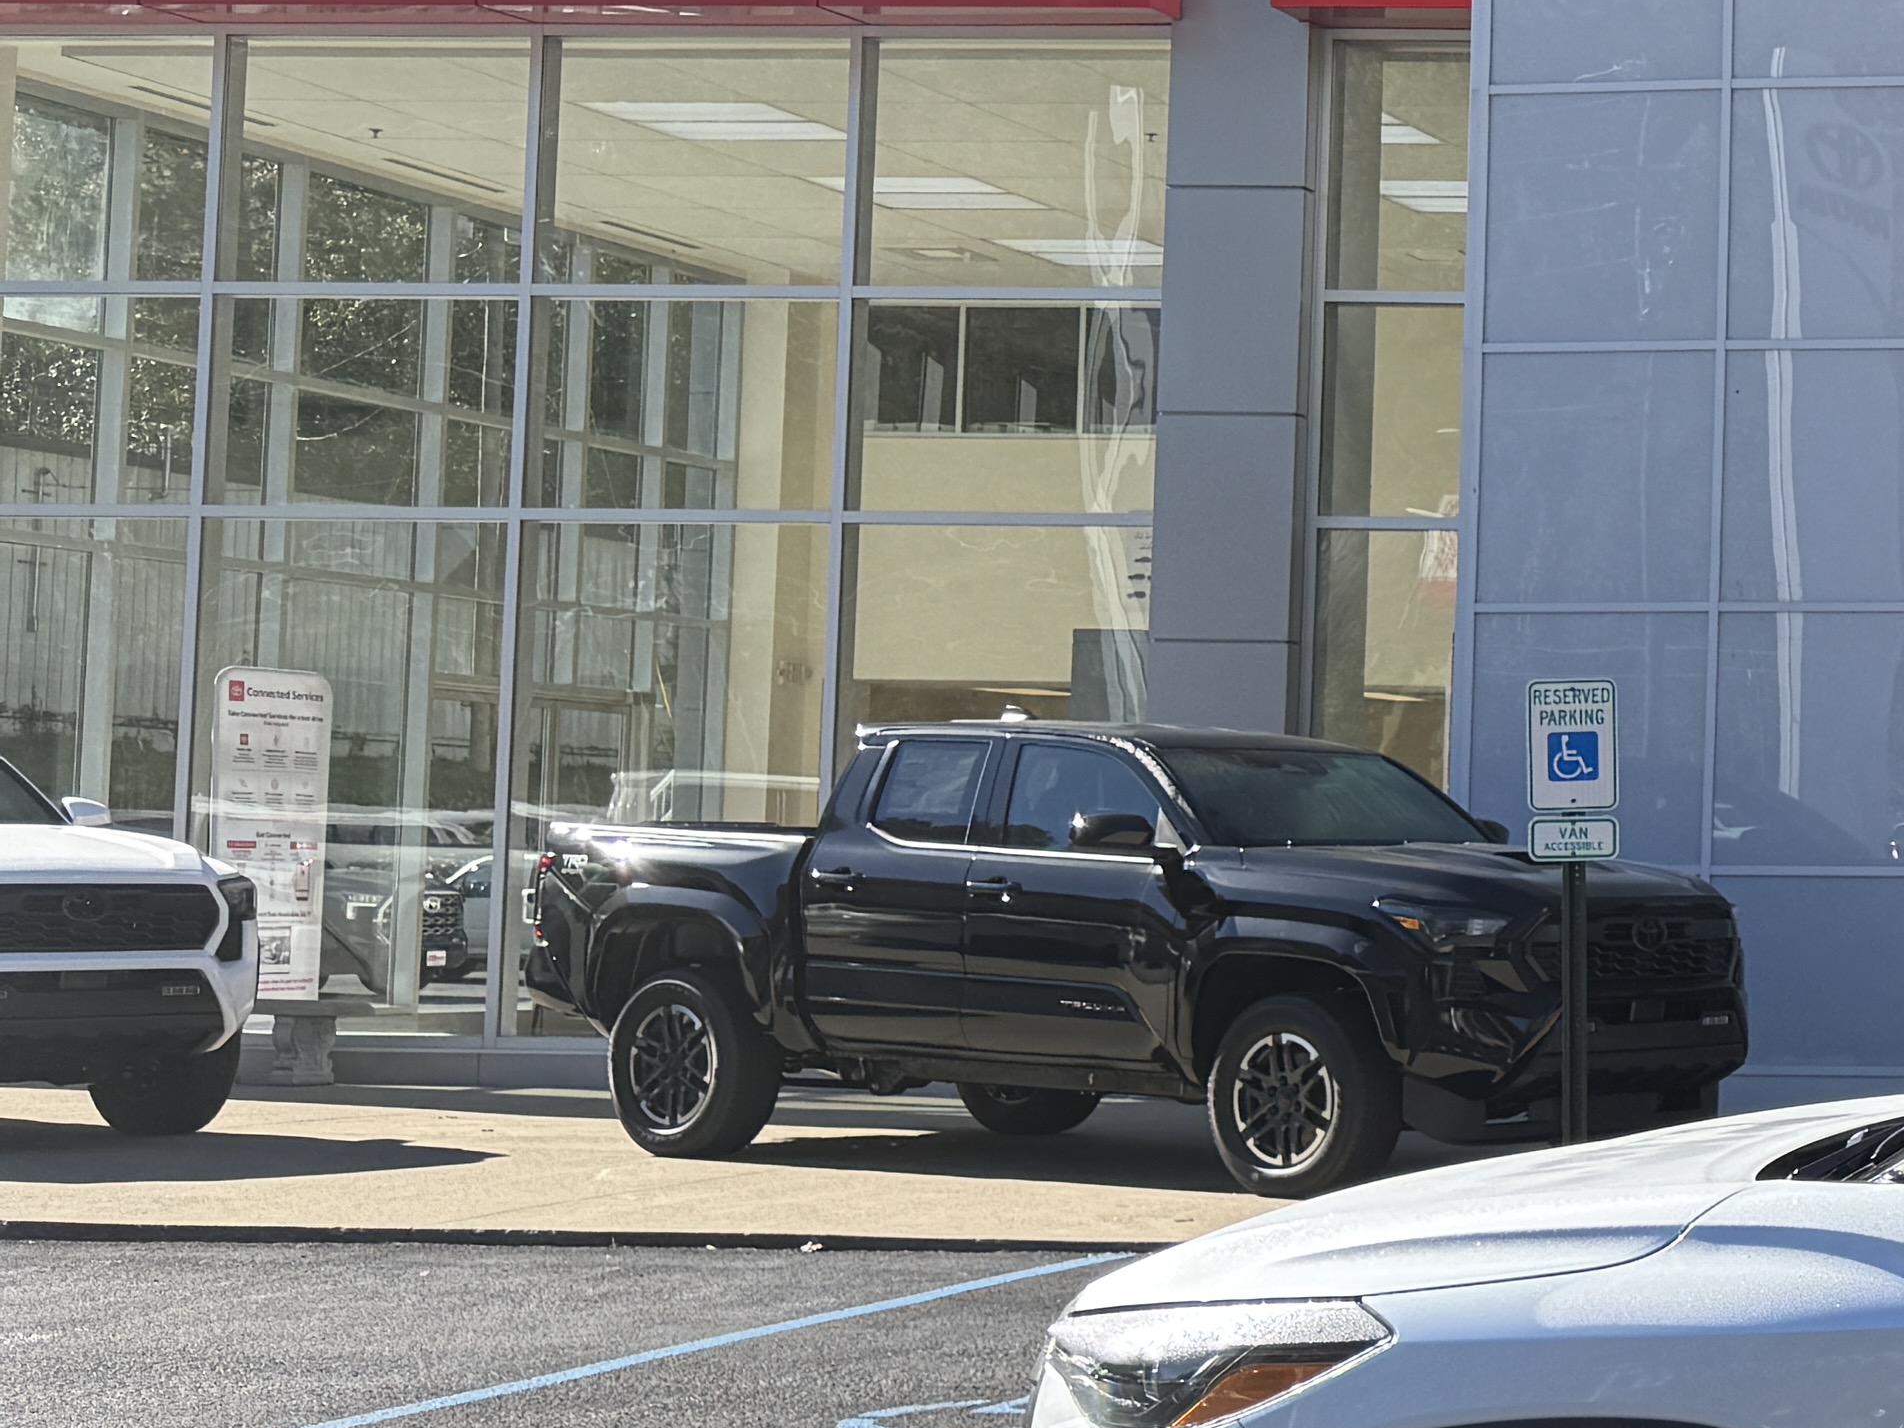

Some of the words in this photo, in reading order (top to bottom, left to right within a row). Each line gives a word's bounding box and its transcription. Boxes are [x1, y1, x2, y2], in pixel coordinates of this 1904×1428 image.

[246, 687, 291, 700] Connected
[292, 690, 324, 702] Services
[1533, 687, 1610, 706] RESERVED
[1539, 709, 1605, 726] PARKING
[1559, 827, 1589, 840] VAN
[1544, 841, 1604, 851] ACCESSIBLE
